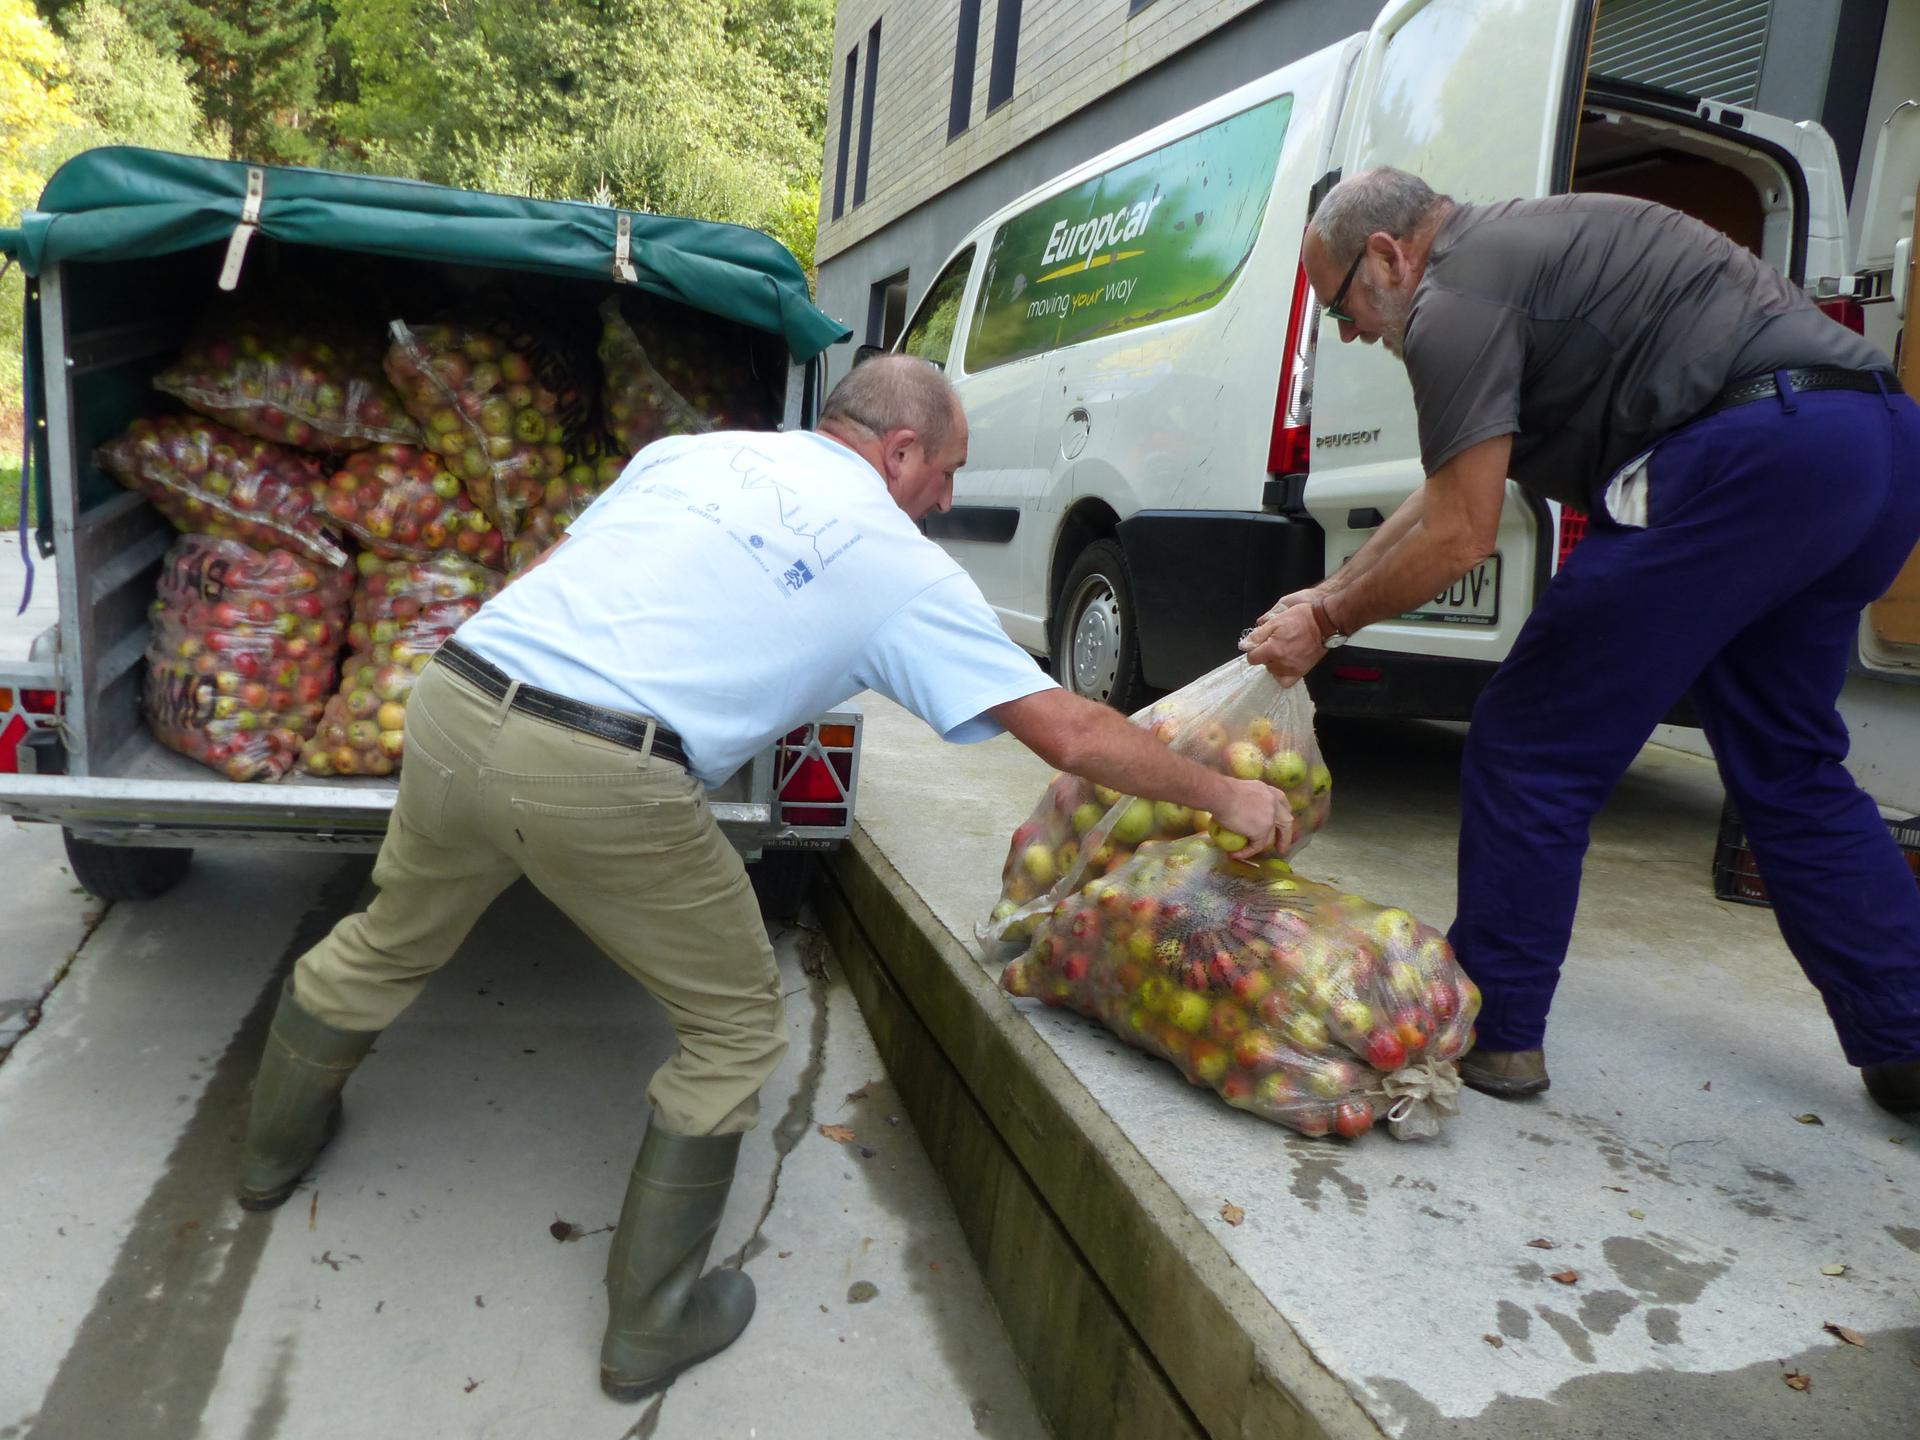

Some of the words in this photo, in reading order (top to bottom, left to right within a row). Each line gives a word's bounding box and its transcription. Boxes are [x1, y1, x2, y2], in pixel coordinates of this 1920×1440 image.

[1040, 196, 1162, 270] Europcar
[1026, 291, 1070, 319] moving
[1071, 287, 1105, 316] your
[1315, 428, 1382, 448] PEUGEOT
